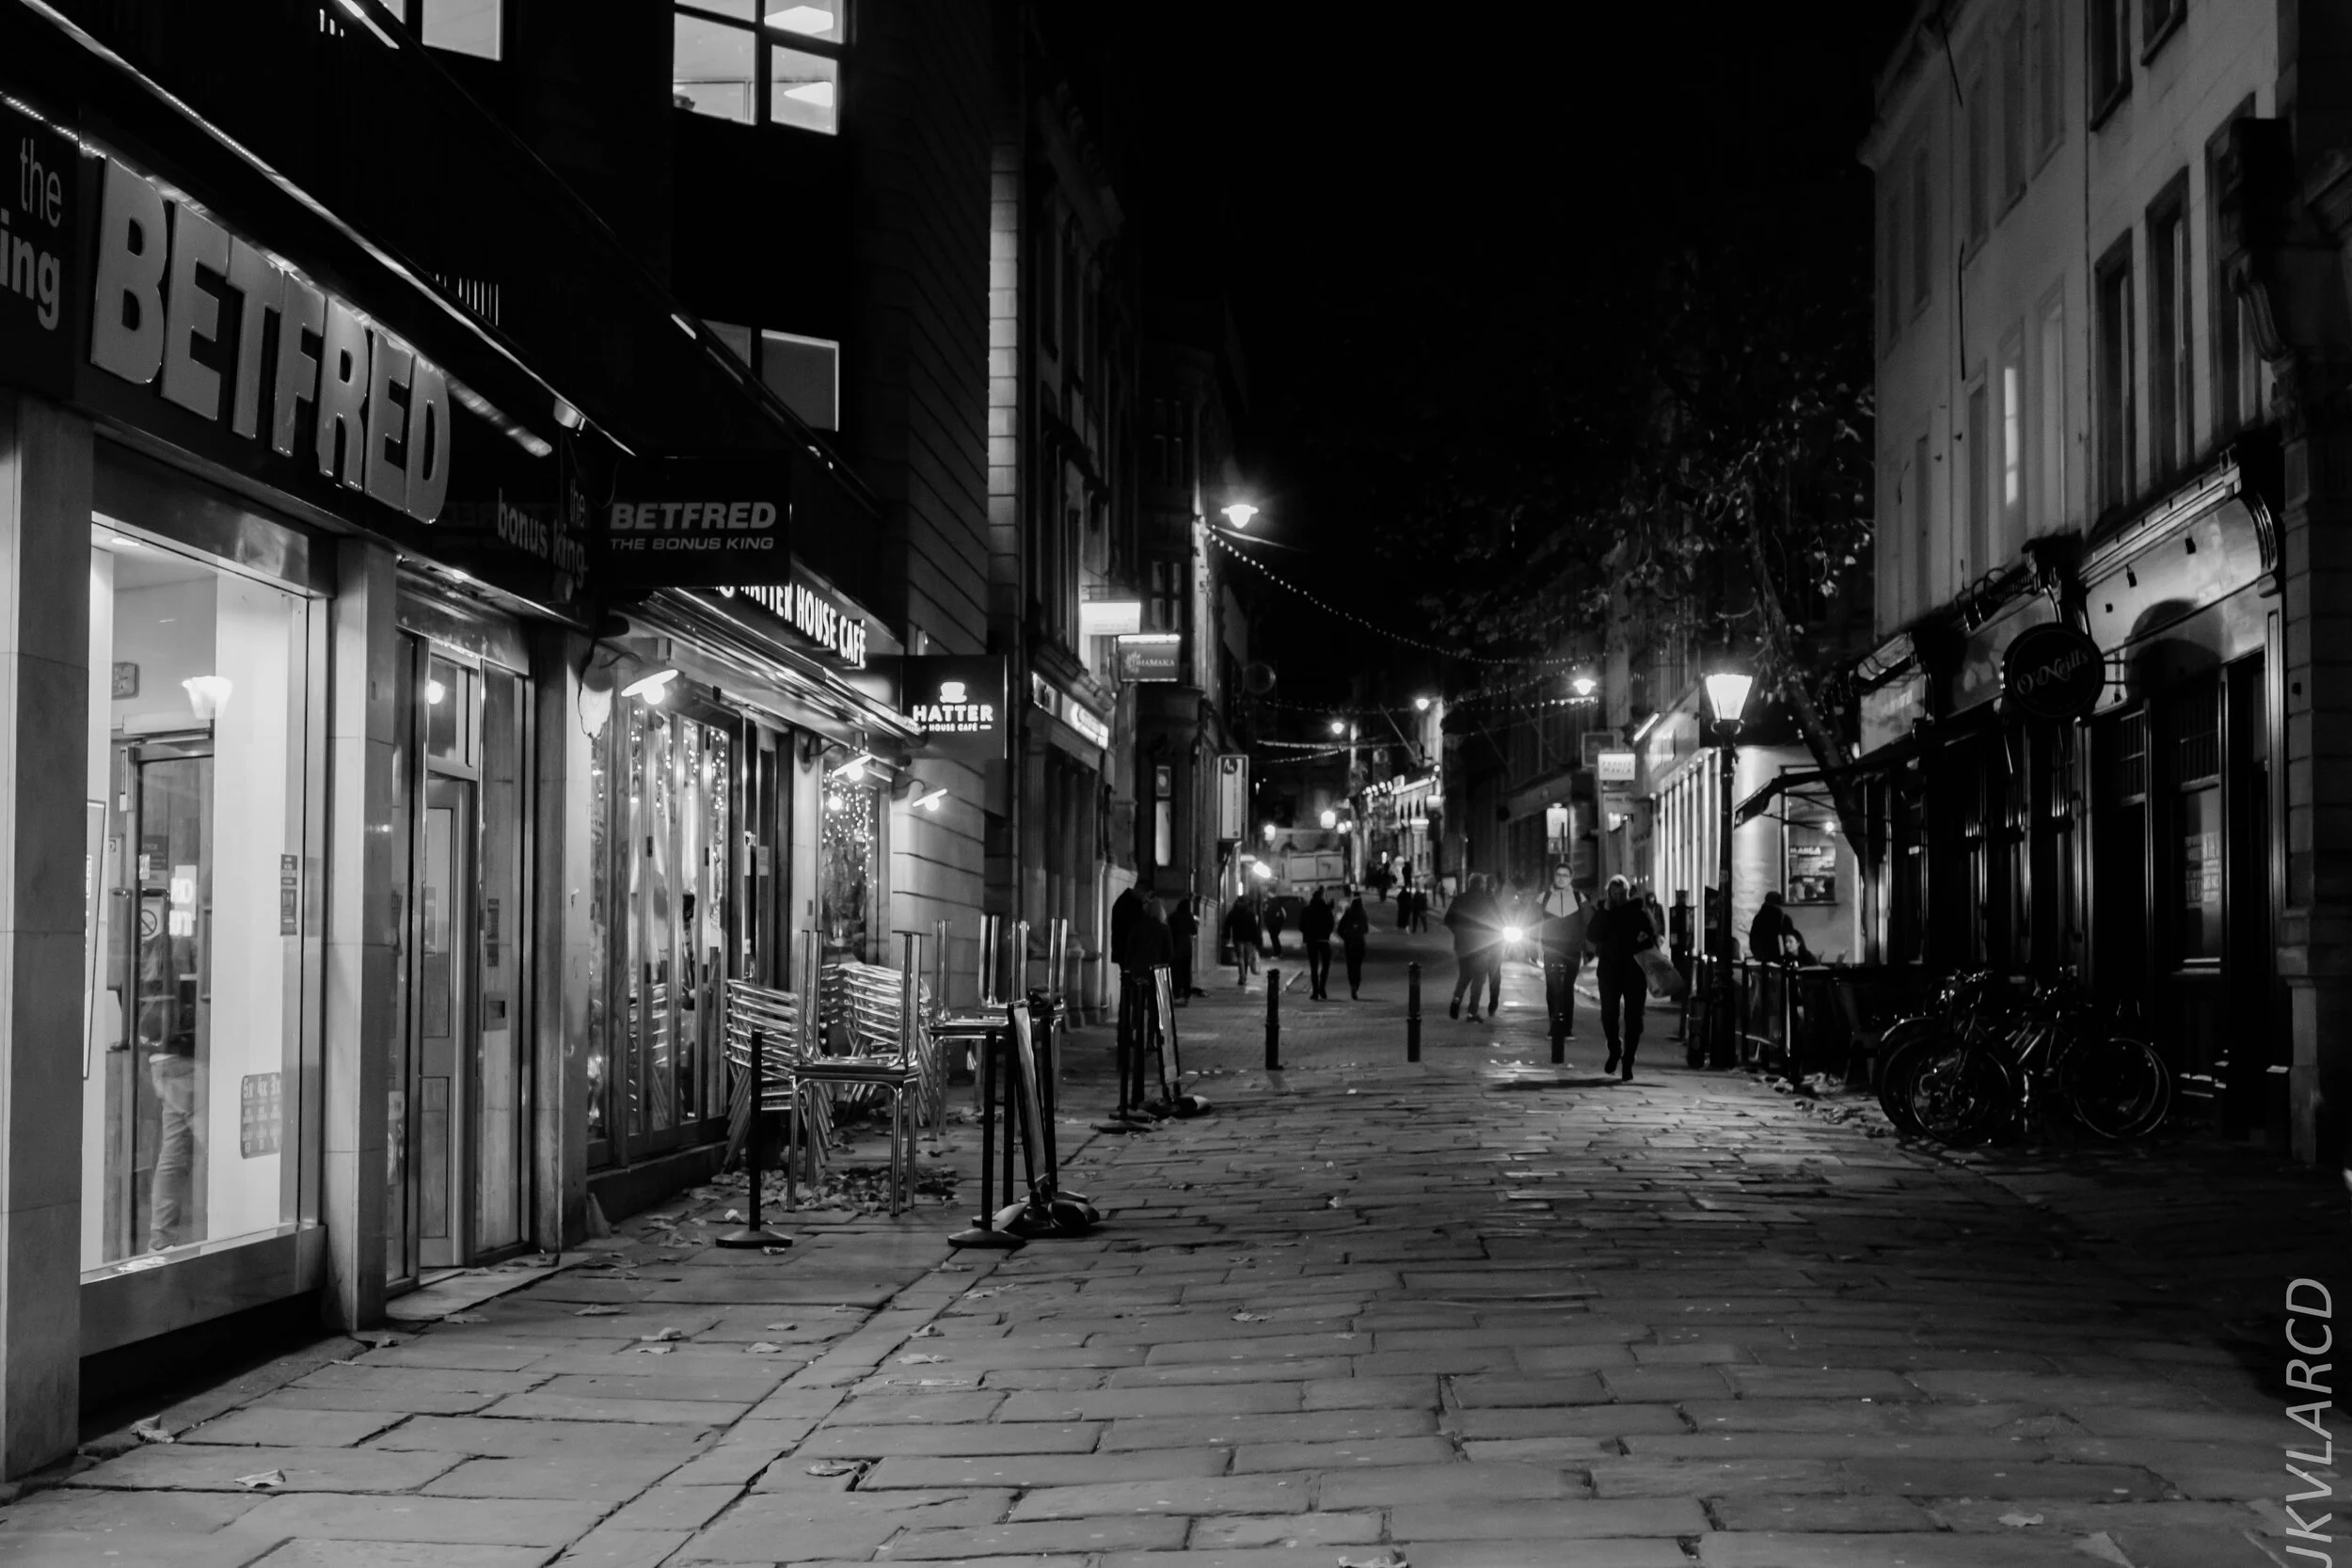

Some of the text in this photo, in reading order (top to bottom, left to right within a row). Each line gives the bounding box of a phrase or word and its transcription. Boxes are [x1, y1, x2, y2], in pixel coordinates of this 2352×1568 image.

[20, 136, 62, 228] the
[91, 155, 451, 524] BETFRED
[498, 486, 549, 560] bonus
[610, 501, 776, 530] BETFRED
[610, 536, 774, 550] THE BONUS KING
[796, 583, 837, 651] HOUSE
[839, 614, 866, 670] CAFÉ
[913, 705, 993, 722] HATTER
[929, 721, 978, 733] HOUSE CAFÉ
